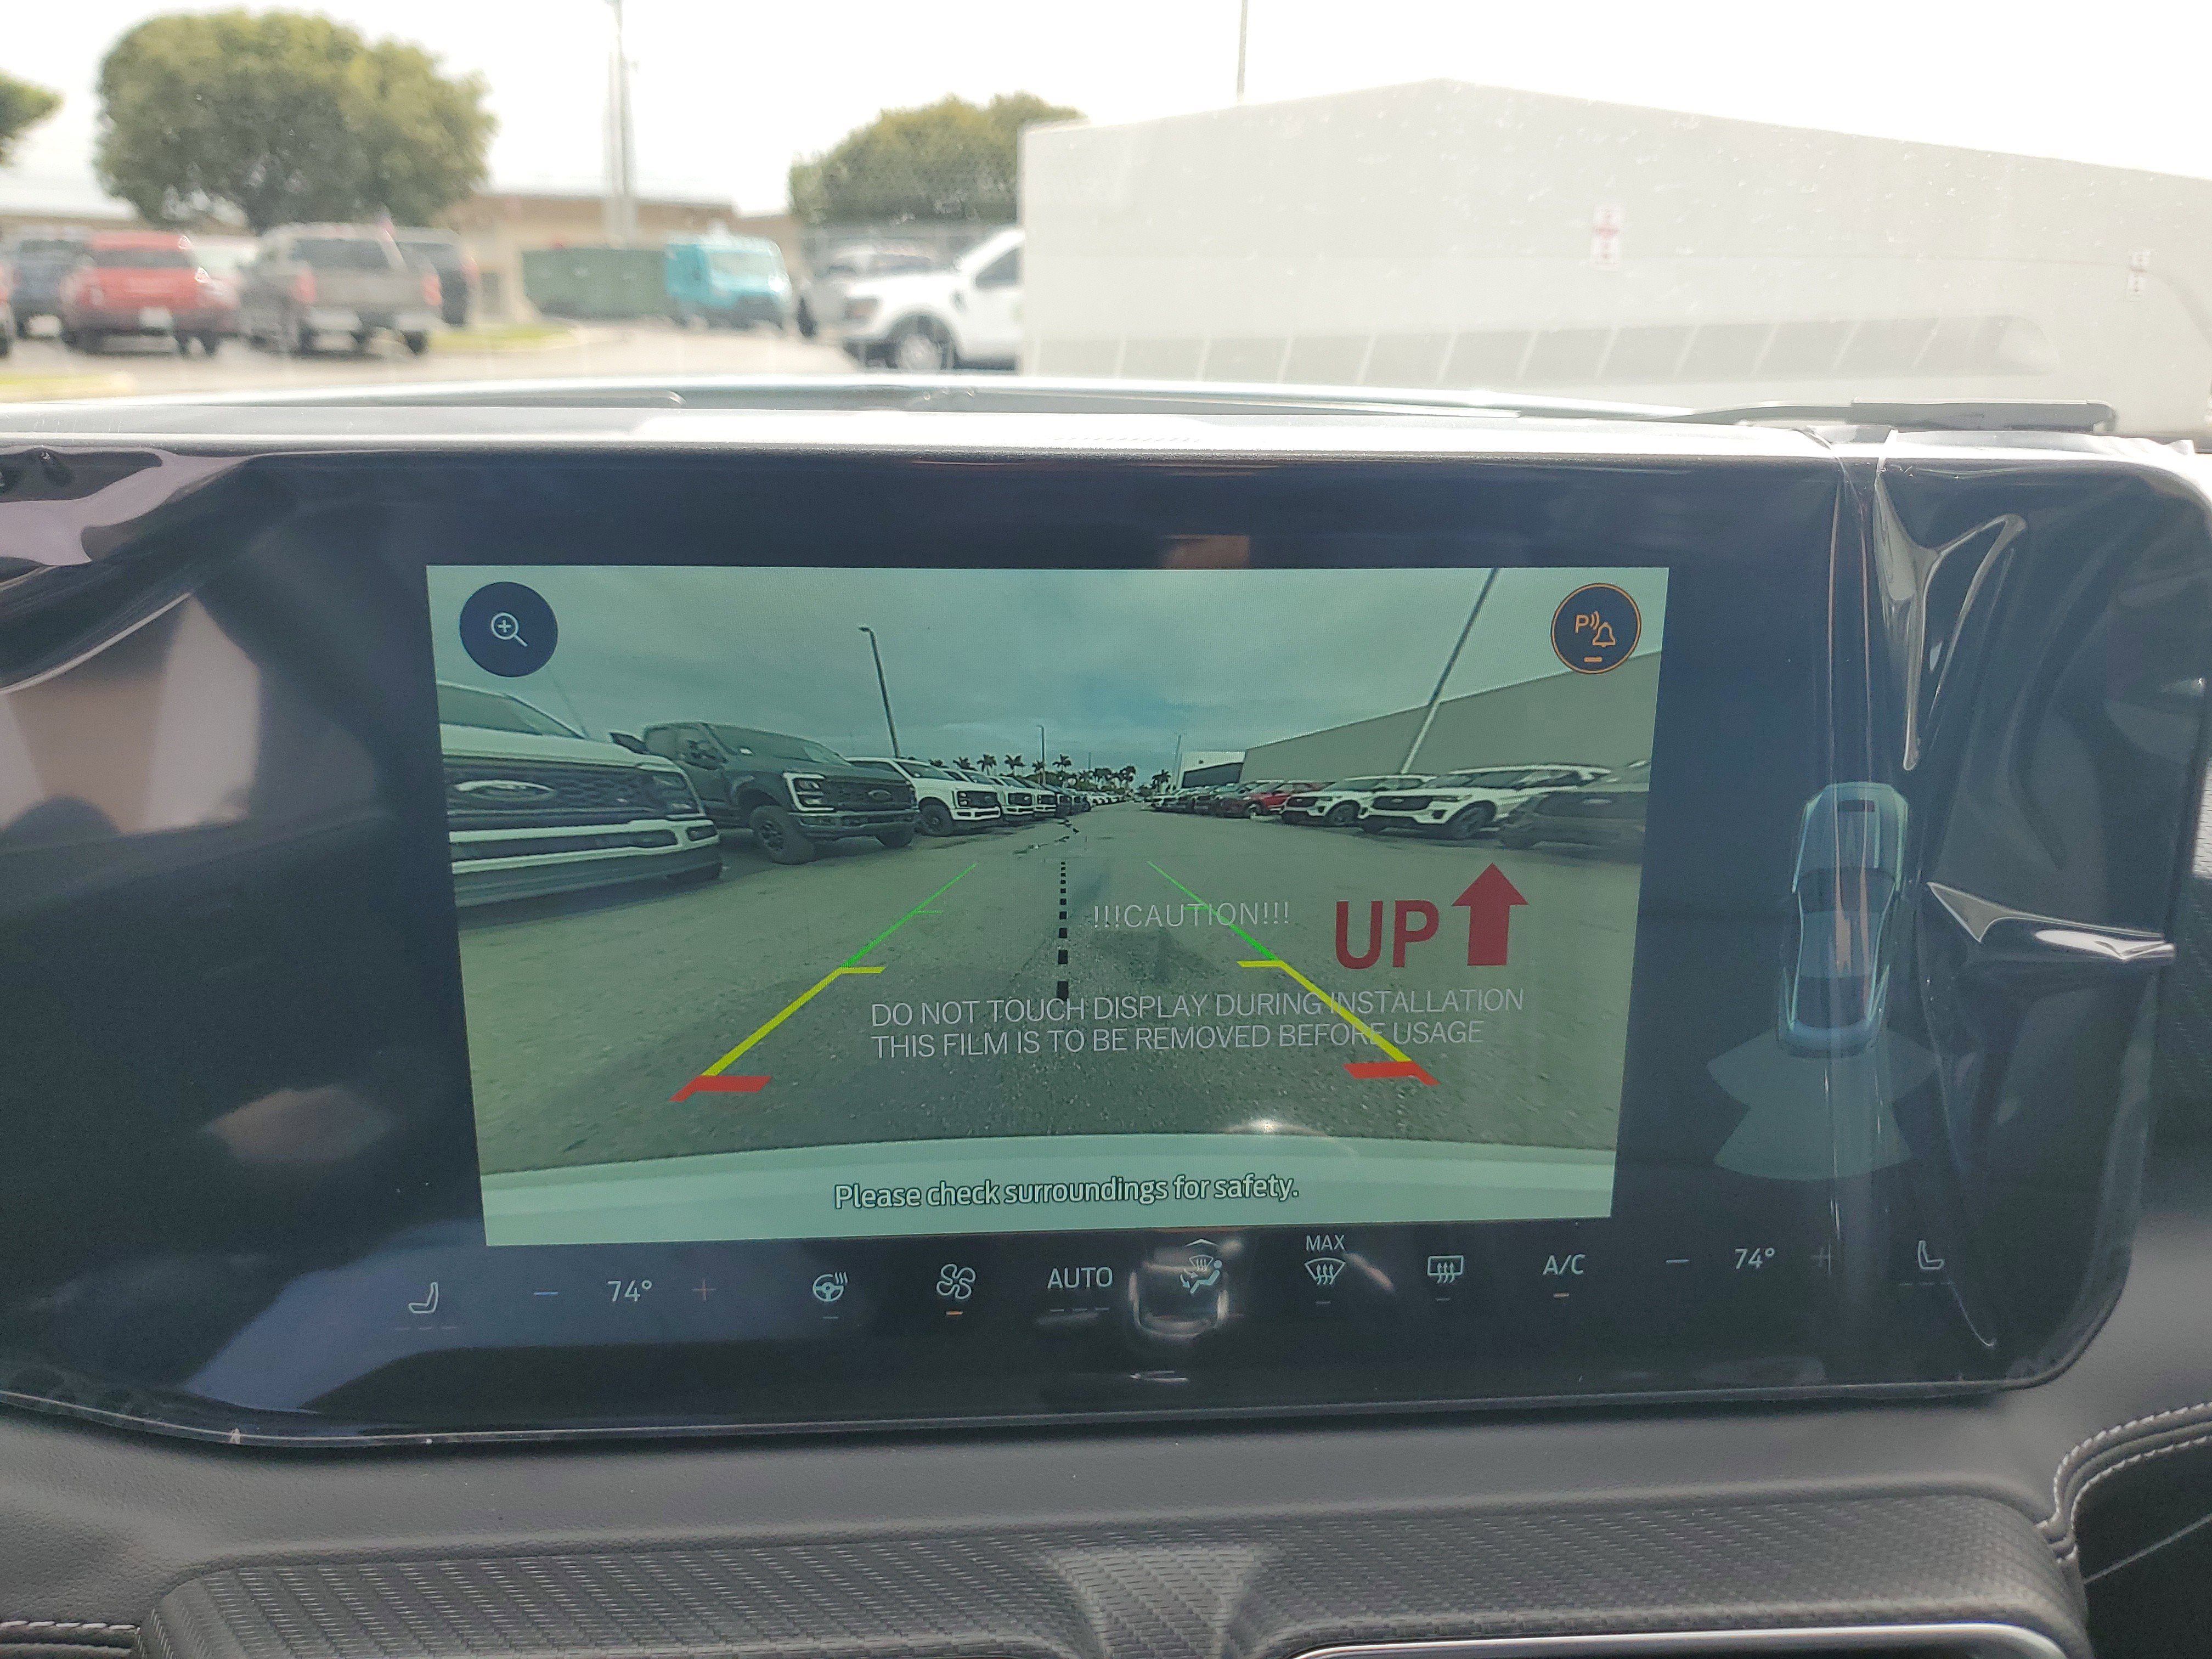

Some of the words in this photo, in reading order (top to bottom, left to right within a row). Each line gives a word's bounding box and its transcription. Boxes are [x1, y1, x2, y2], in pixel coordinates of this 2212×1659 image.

[1335, 900, 1440, 969] UP
[872, 1003, 913, 1027] DO
[921, 1000, 980, 1025] NOT
[987, 997, 1085, 1023] TOUCH
[1094, 994, 1208, 1020] DISPLAY
[1216, 992, 1321, 1017] DURING
[1330, 988, 1523, 1014] INSTALLATION
[871, 1034, 935, 1059] THIS
[943, 1031, 1008, 1056] FILM
[1018, 1029, 1040, 1054] IS
[1047, 1028, 1085, 1053] TO
[1093, 1028, 1128, 1052] BE
[1135, 1025, 1271, 1050] REMOVED
[1279, 1022, 1386, 1047] BEFORE
[1393, 1020, 1485, 1045] USAGE
[834, 1183, 921, 1209] Please
[926, 1180, 1001, 1206] check
[1003, 1176, 1169, 1205] surroundings
[1173, 1175, 1211, 1200] for
[1213, 1172, 1300, 1203] safety.
[1305, 1234, 1346, 1252] MAX
[1543, 1254, 1585, 1276] A/C
[1734, 1247, 1776, 1270] 74°
[1047, 1266, 1114, 1290] AUTO
[607, 1279, 652, 1302] 74°
